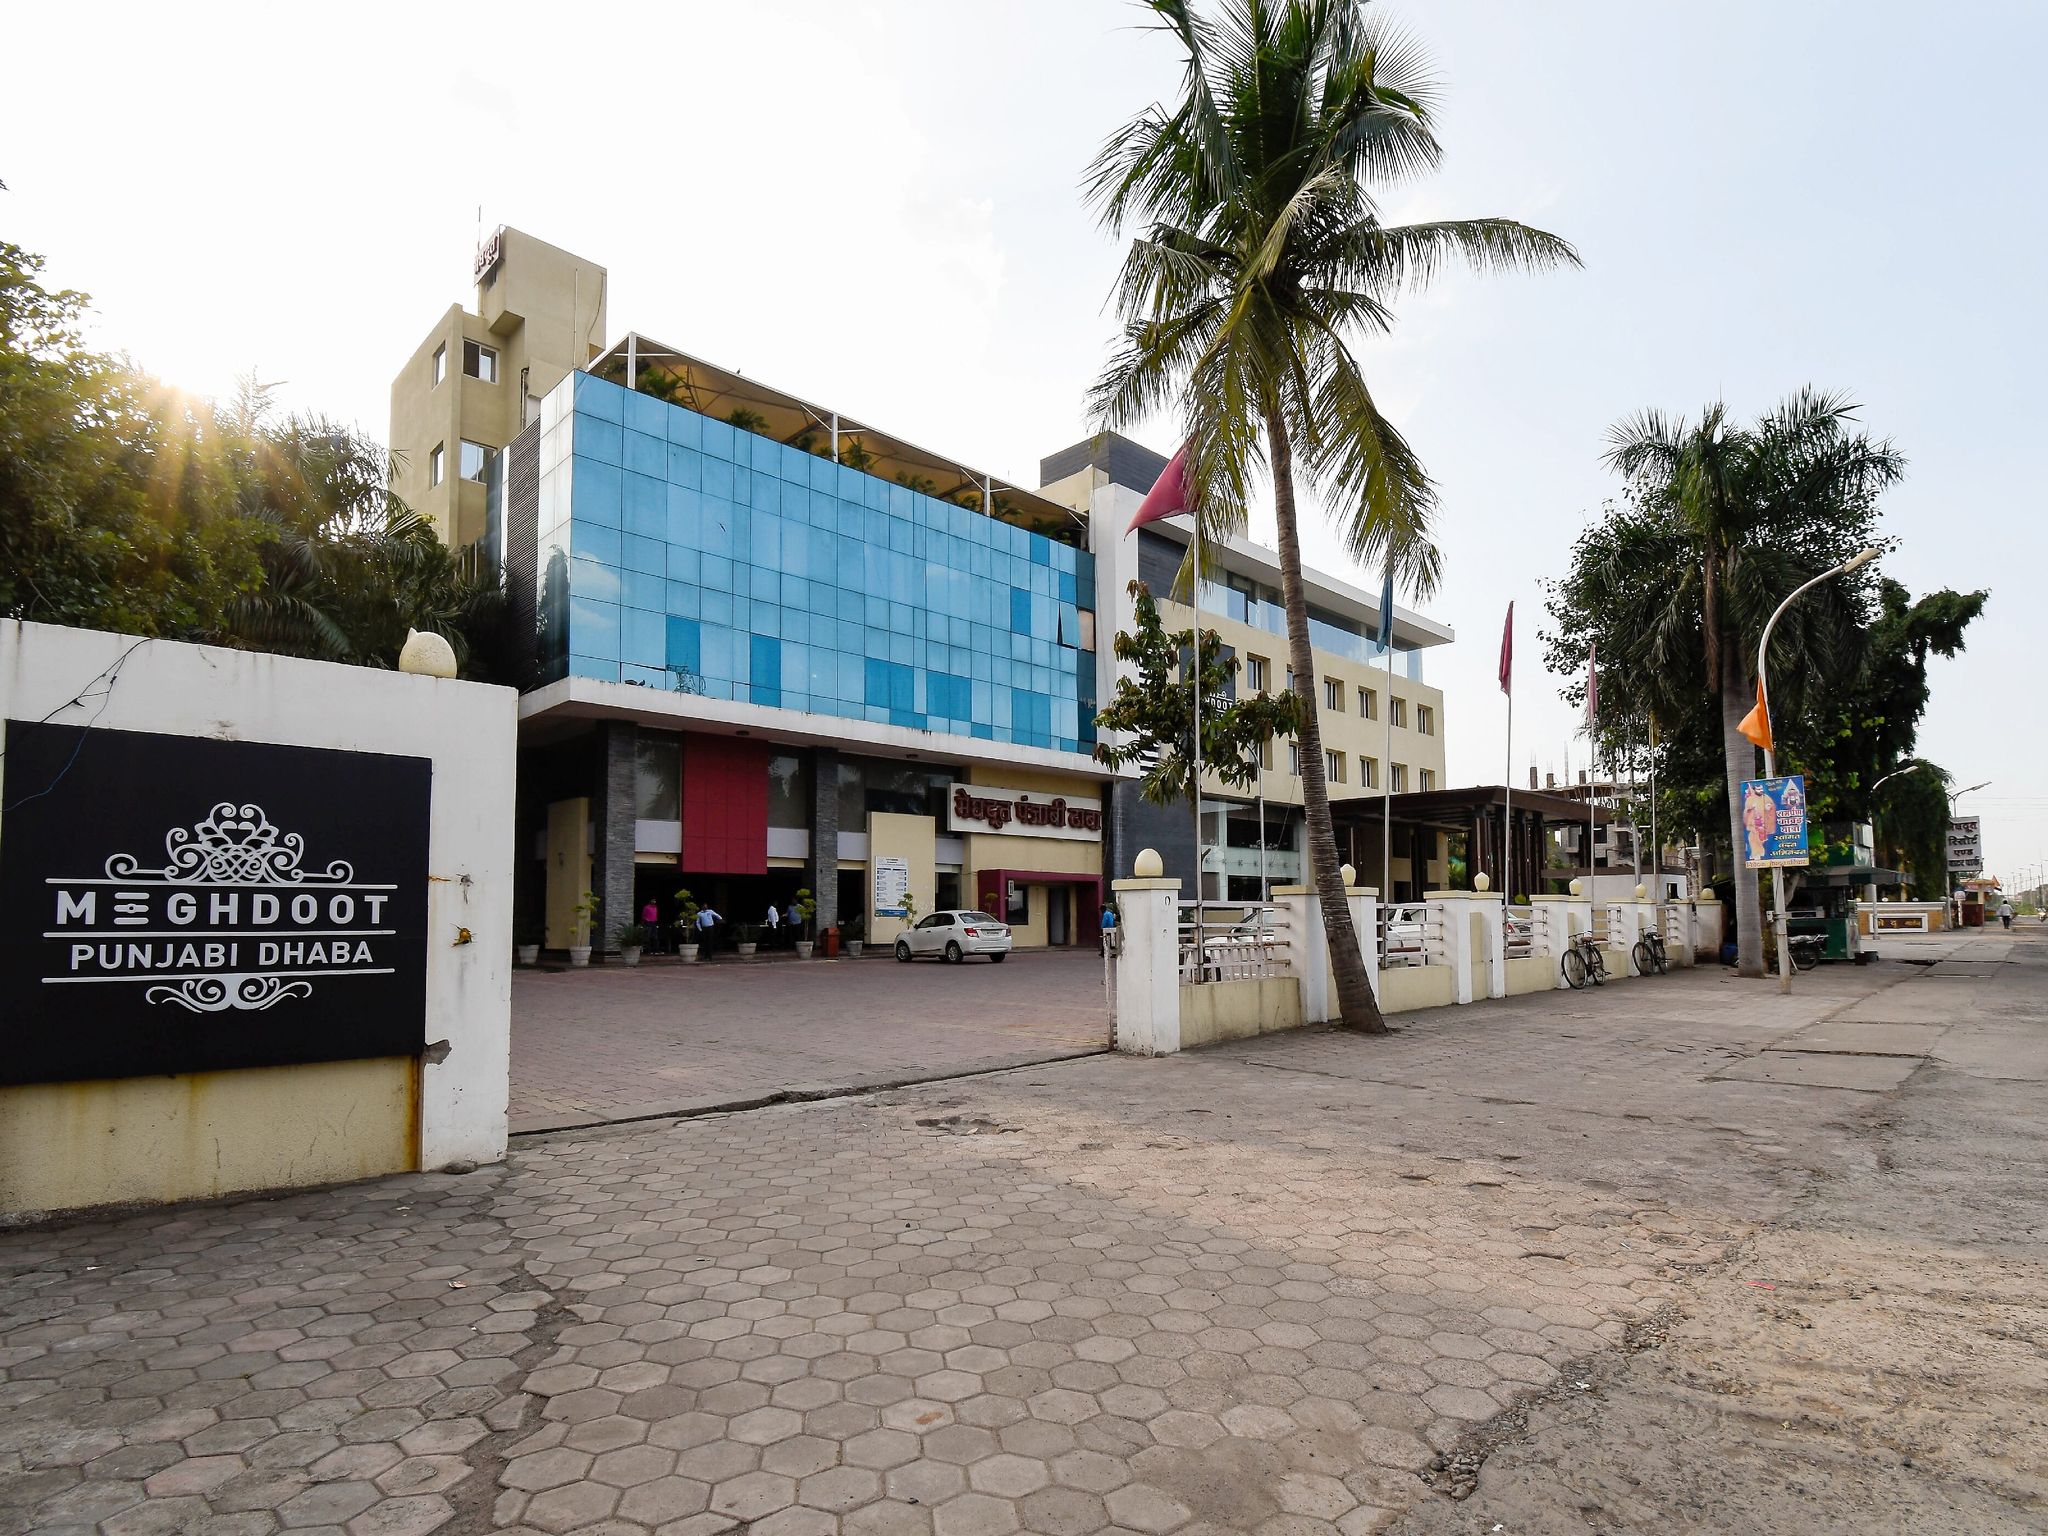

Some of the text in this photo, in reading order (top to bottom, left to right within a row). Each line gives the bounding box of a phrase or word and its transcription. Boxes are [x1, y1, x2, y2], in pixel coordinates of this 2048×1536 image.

[954, 788, 1012, 829] मेघदूत
[1014, 795, 1066, 827] पंजाबी
[57, 890, 388, 925] MEGHDOOT
[71, 941, 373, 970] PUNJABI DHABA
